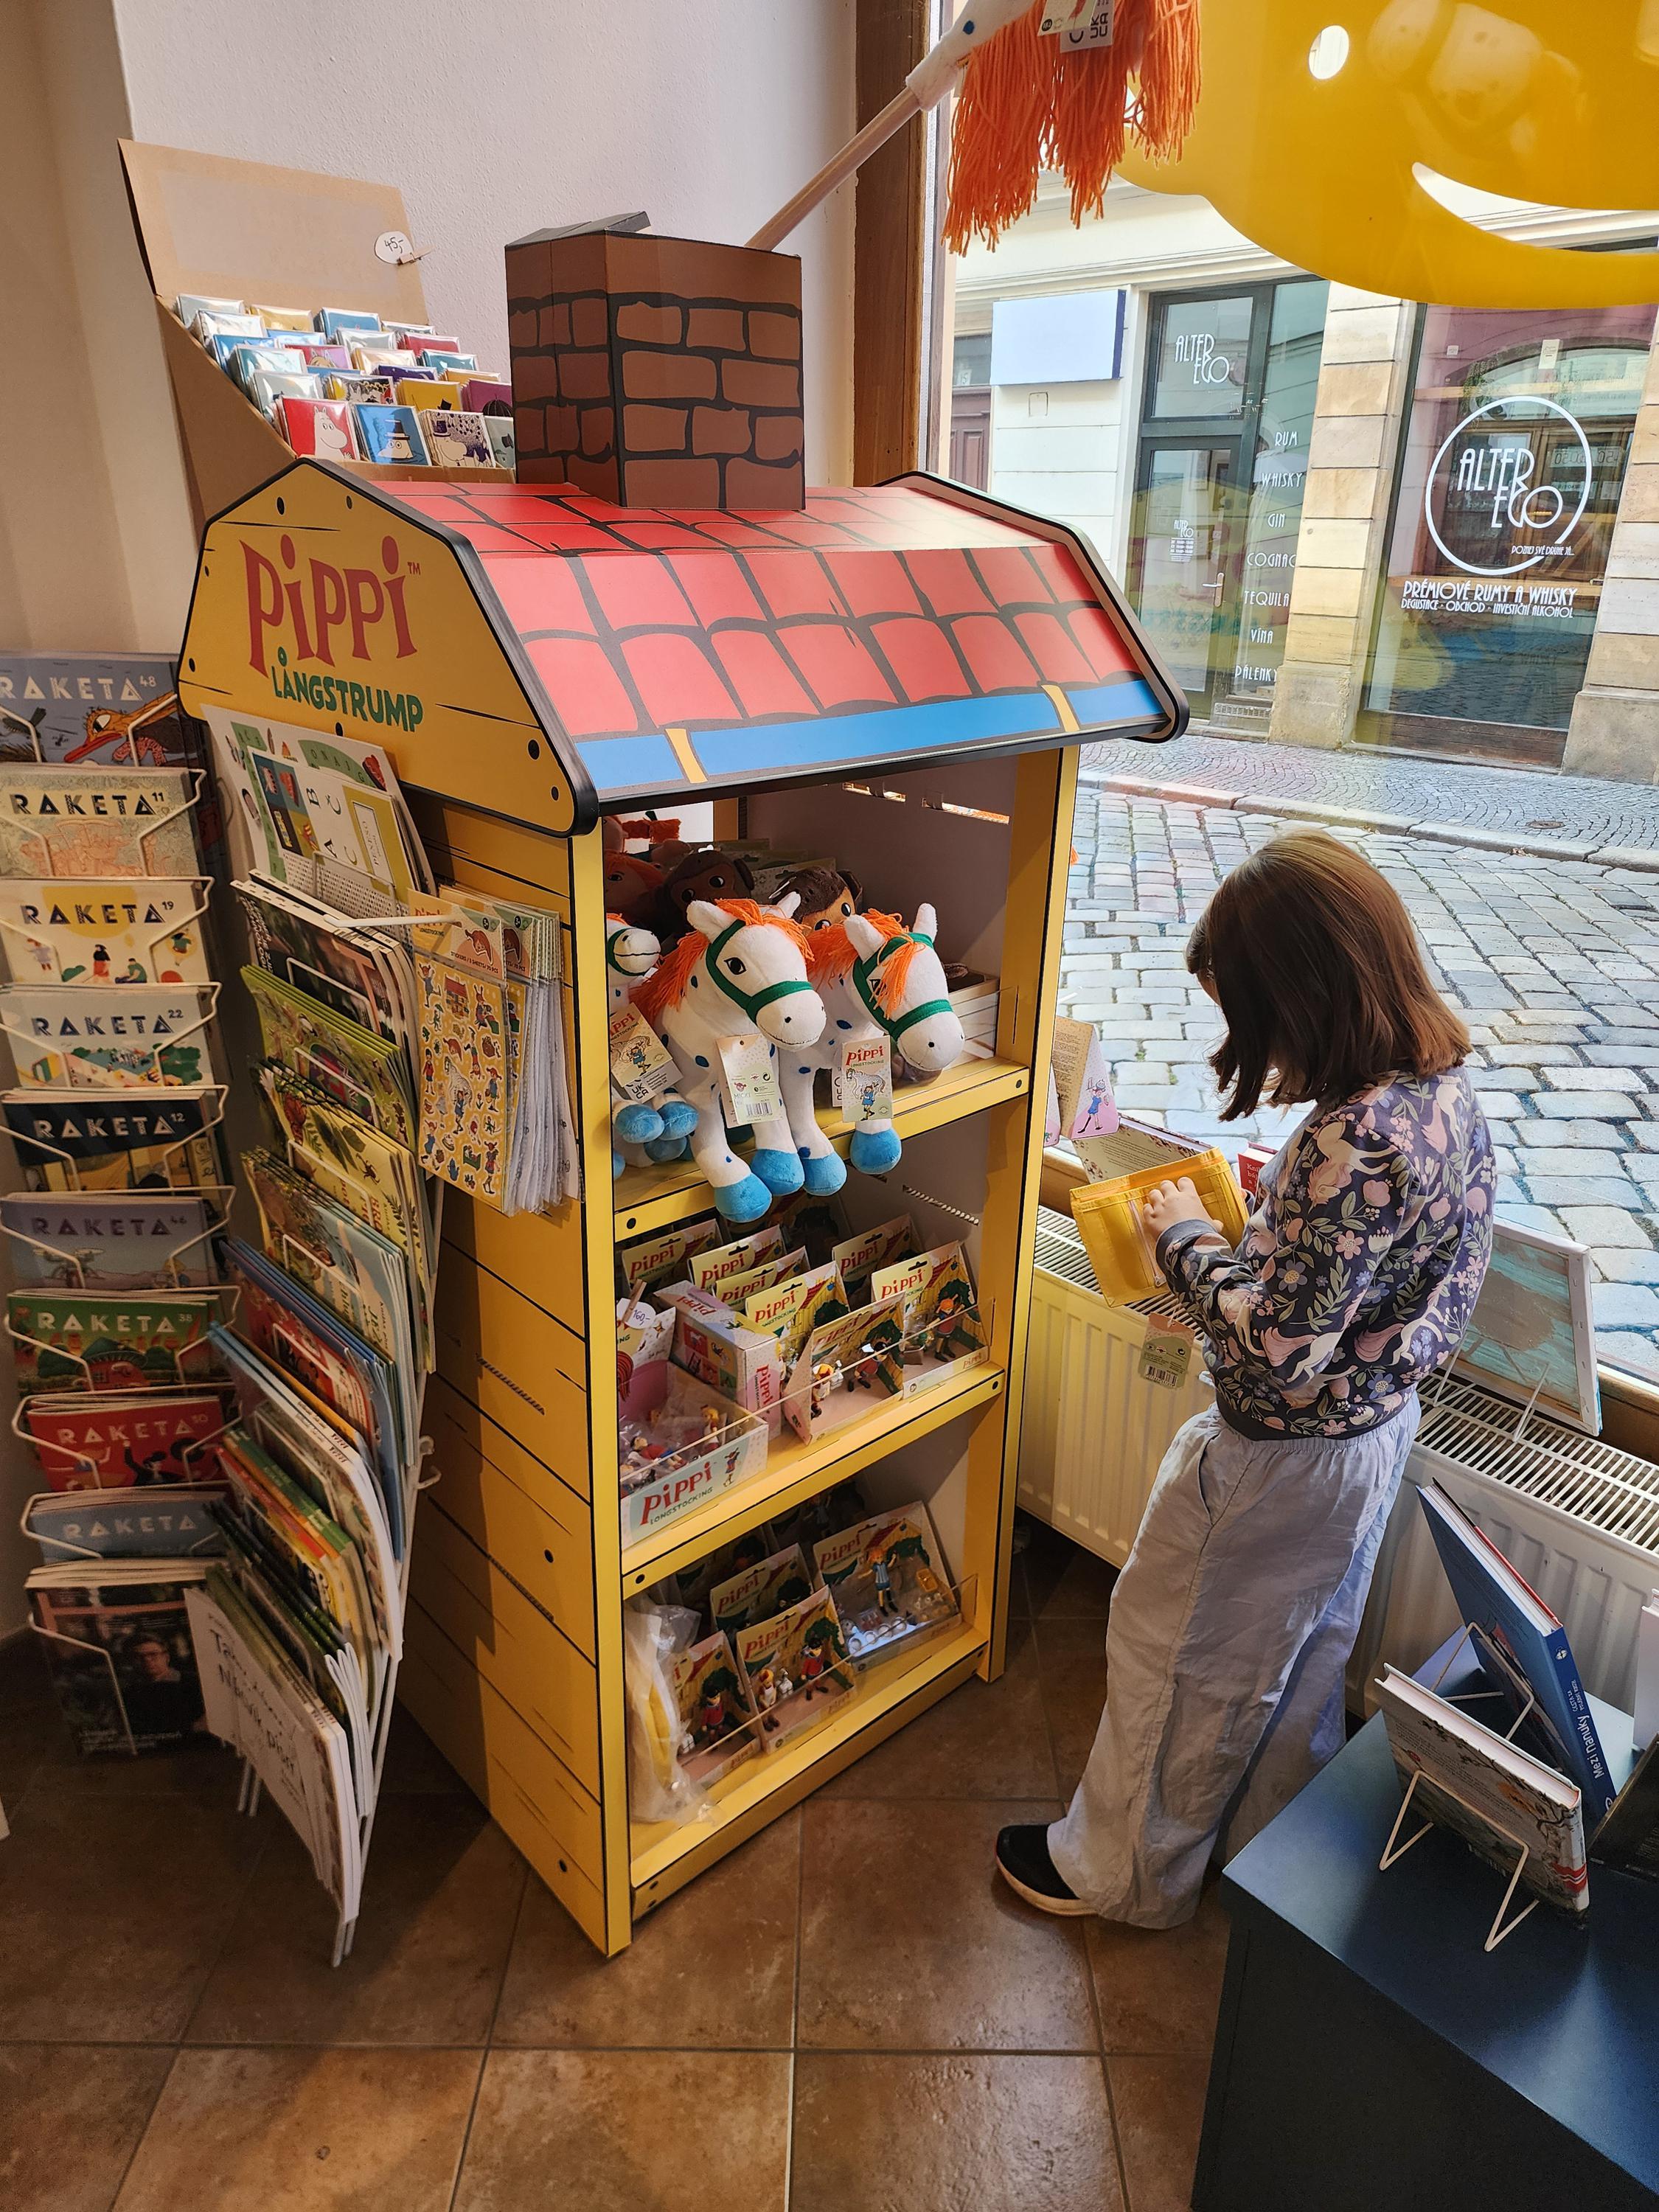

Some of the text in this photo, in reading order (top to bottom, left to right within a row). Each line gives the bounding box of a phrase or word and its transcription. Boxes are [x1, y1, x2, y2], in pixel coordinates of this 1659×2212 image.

[1175, 334, 1215, 362] ALTER
[1275, 431, 1298, 447] RUM
[1261, 473, 1303, 488] WHISKY
[1457, 448, 1536, 491] ALTER
[1267, 512, 1286, 528] GIN
[1247, 552, 1296, 568] COGNAC
[1244, 591, 1290, 608] TEQUILA
[1402, 578, 1578, 606] PRÉMIOVÉ RUMY A WHISKY
[1402, 598, 1573, 619] DEGUSTACE OBCHOD INVESTIČNÍ ALKOHOL
[1251, 627, 1273, 644] VÍNA
[0, 675, 157, 701] RAKETA 48
[271, 646, 423, 732] LÅNGSTRUMP
[10, 792, 164, 815] RAKETA 11
[20, 901, 174, 925] RAKETA 19
[31, 1009, 184, 1037] RAKETA 22
[33, 1112, 186, 1139] RAKETA 12
[31, 1217, 172, 1237] RAKETA
[38, 1312, 178, 1333] RAKETA
[58, 1419, 195, 1444] RAKETA
[650, 1486, 713, 1525] LONGSTOCKING
[62, 1514, 198, 1540] RAKETA
[1577, 1714, 1605, 1779] Mezi nanuky
